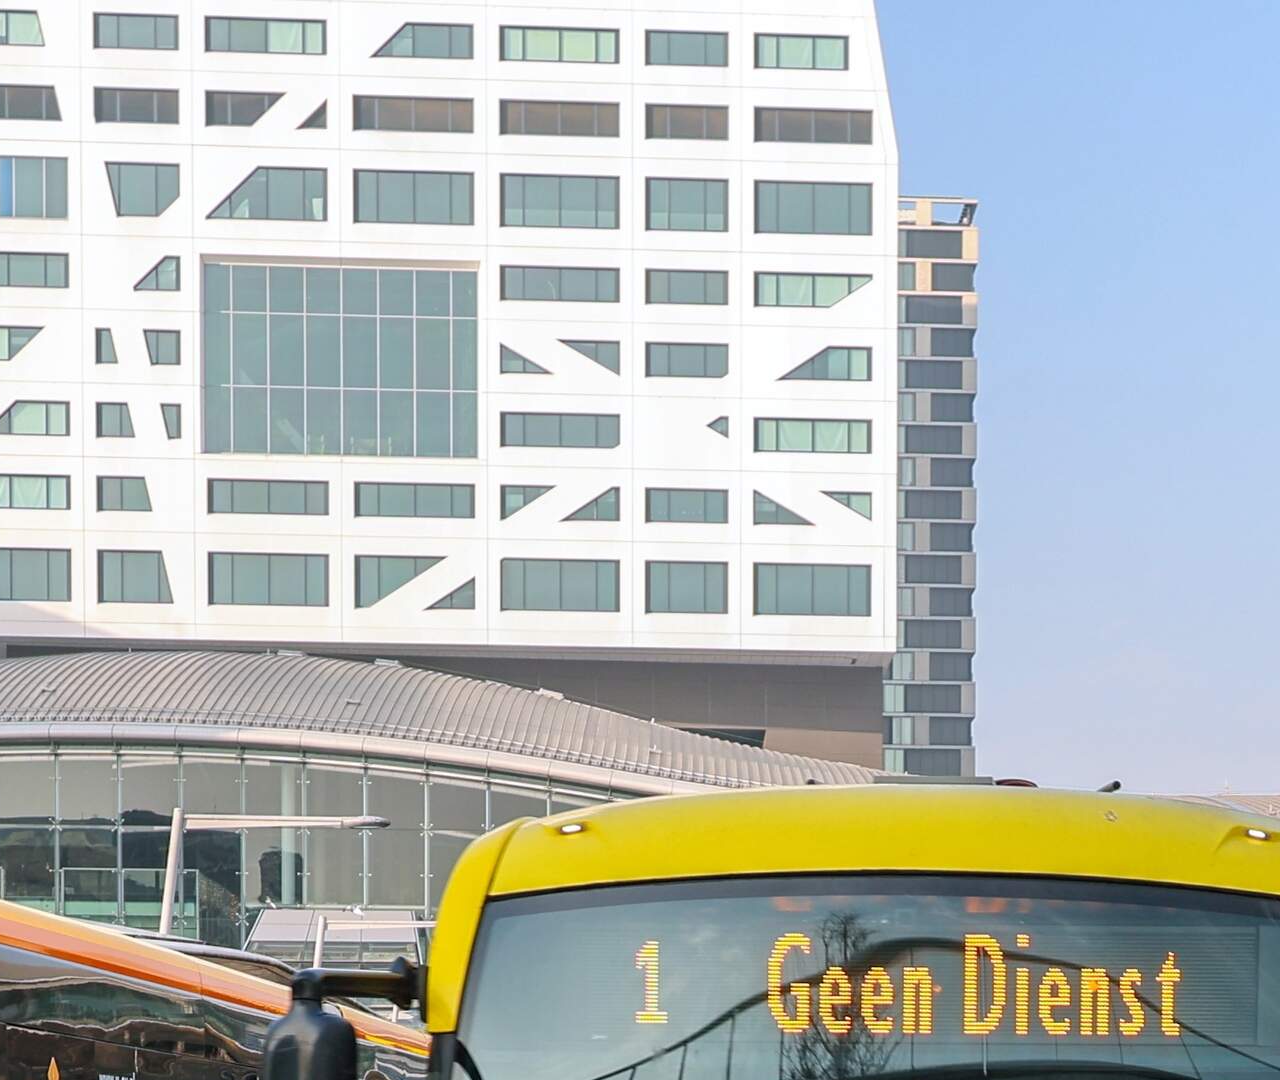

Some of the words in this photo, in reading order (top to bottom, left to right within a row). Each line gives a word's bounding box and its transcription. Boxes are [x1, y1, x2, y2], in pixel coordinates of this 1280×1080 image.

[635, 940, 669, 1024] 1
[767, 932, 932, 1035] Geen
[962, 933, 1183, 1036] Dienst
